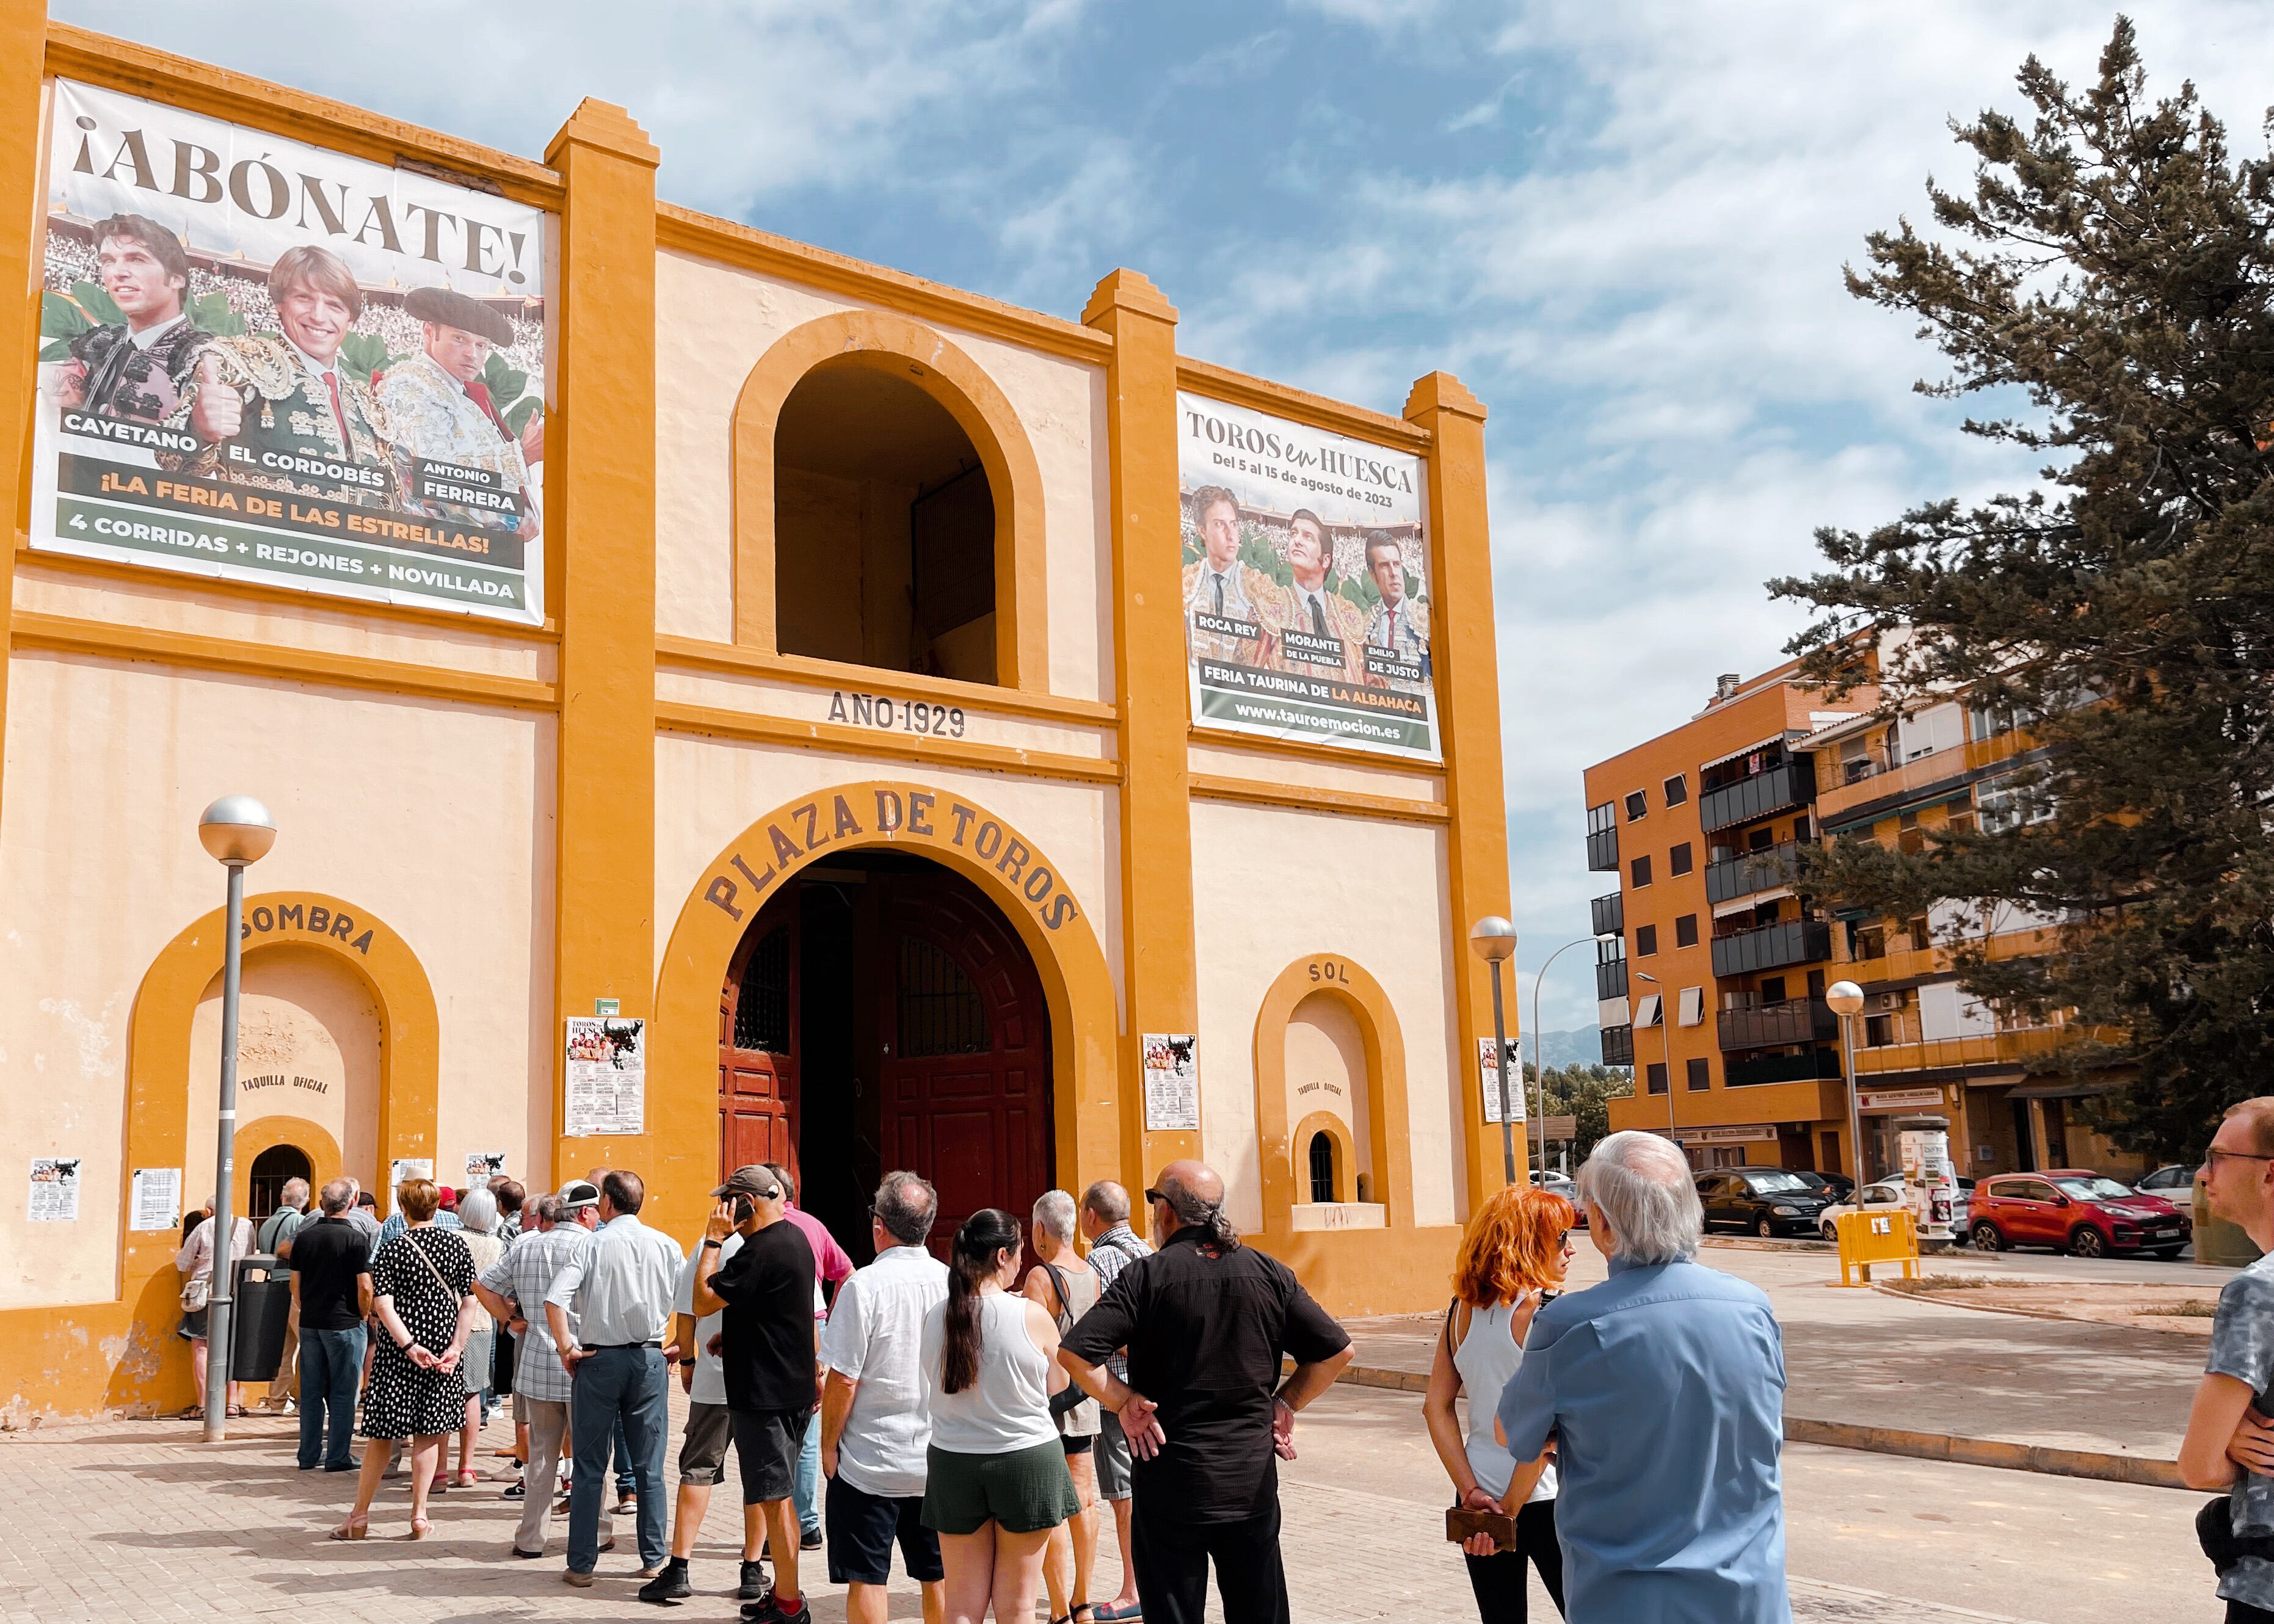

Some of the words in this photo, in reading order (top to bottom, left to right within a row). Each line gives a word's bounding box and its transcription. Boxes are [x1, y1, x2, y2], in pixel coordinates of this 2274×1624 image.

[73, 115, 526, 284] ¡ABÓNATE!
[64, 414, 198, 452] CAYETANO
[229, 444, 257, 463] EL
[262, 452, 385, 487] CORDOBÉS
[1186, 411, 1282, 459] TOROS
[1285, 442, 1317, 468] en
[1318, 447, 1412, 494] HUESCA
[423, 463, 491, 484] ANTONIO
[1213, 452, 1235, 469] Del
[1238, 459, 1246, 471] 5
[1250, 462, 1262, 475] al
[1265, 466, 1277, 479] 15
[1281, 470, 1297, 484] de
[1301, 477, 1343, 496] agosto
[1346, 486, 1362, 500] de
[1365, 491, 1393, 508] 2023
[101, 472, 149, 496] ¡LA
[156, 480, 239, 511] FERIA
[246, 496, 283, 518] DE
[290, 504, 340, 527] LAS
[347, 514, 489, 554] ESTRELLAS!
[424, 481, 517, 512] FERRERA
[68, 513, 88, 530] 4
[94, 517, 229, 553] CORRIDAS
[236, 542, 249, 554] +
[256, 543, 364, 574] REJONES
[370, 564, 382, 575] +
[388, 564, 515, 600] NOVILLADA
[1198, 615, 1232, 633] ROCA
[1235, 622, 1258, 637] REY
[1285, 633, 1342, 653] MORANTE
[1286, 650, 1297, 659] DE
[1298, 652, 1309, 661] LA
[1311, 654, 1342, 667] PUEBLA
[1368, 647, 1396, 659] EMILIO
[1369, 661, 1384, 673] DE
[1386, 664, 1420, 680] JUSTO
[1204, 665, 1246, 685] FERIA
[1247, 672, 1306, 696] TAURINA
[1311, 684, 1329, 699] DE
[1332, 687, 1350, 703] LA
[1352, 691, 1422, 714] ALBAHACA
[1235, 703, 1401, 740] www.tauroemocion.es
[704, 794, 863, 923] PLAZA
[874, 790, 935, 836] DE
[950, 803, 1078, 930] TOROS
[1309, 962, 1350, 984] SOL
[241, 1075, 285, 1092] TAQUILLA
[293, 1076, 329, 1094] OFICIAL
[1297, 1082, 1320, 1096] TAQUILLA
[1324, 1082, 1342, 1096] OFICIAL
